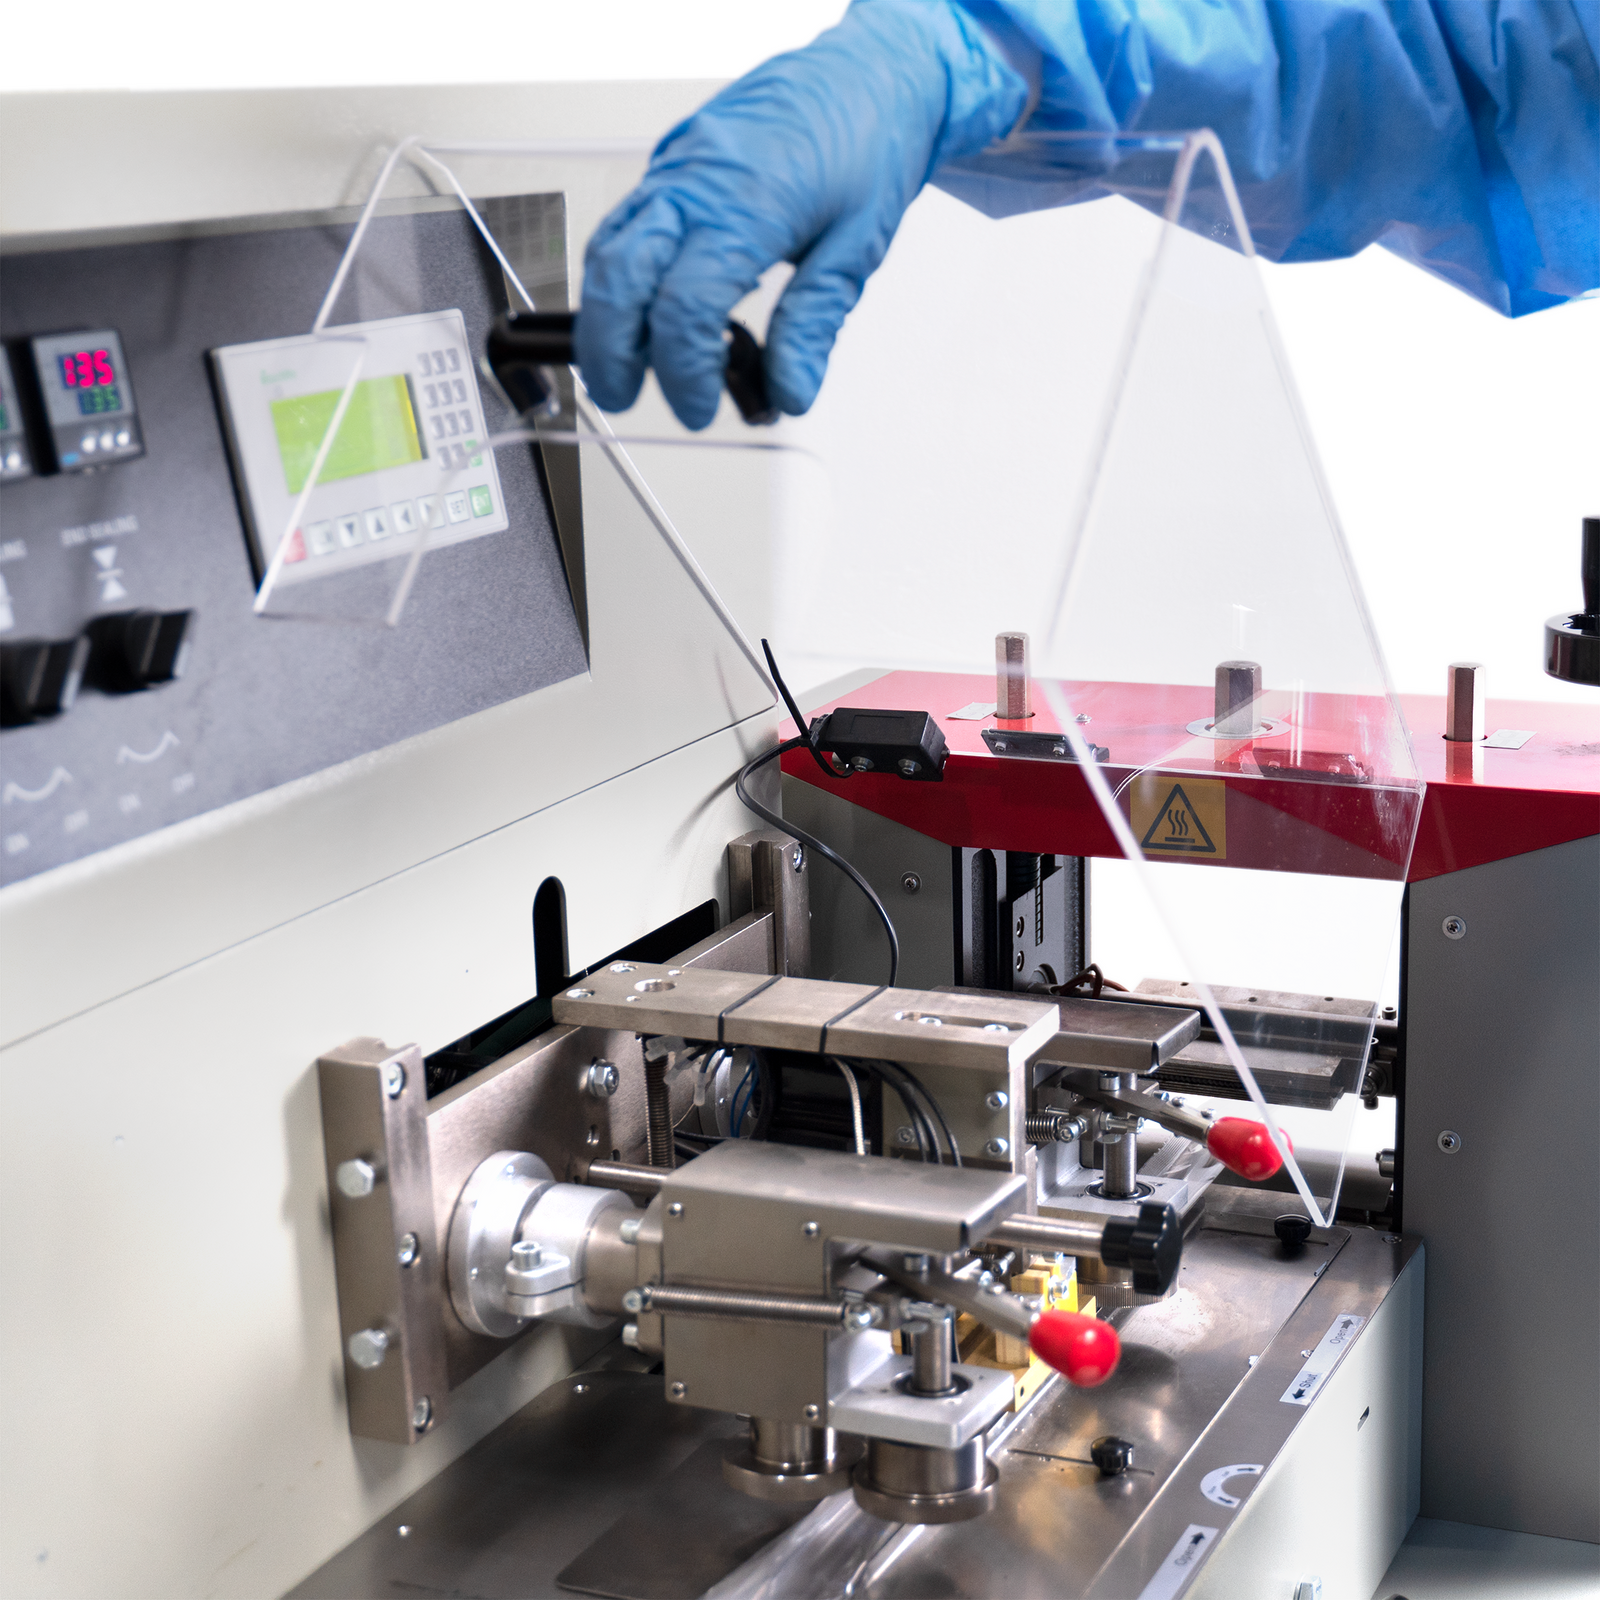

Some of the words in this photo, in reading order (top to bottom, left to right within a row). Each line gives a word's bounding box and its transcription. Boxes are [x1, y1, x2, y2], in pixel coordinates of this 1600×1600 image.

[63, 350, 114, 388] 135
[1329, 1328, 1348, 1345] Open
[1299, 1373, 1318, 1389] Shut
